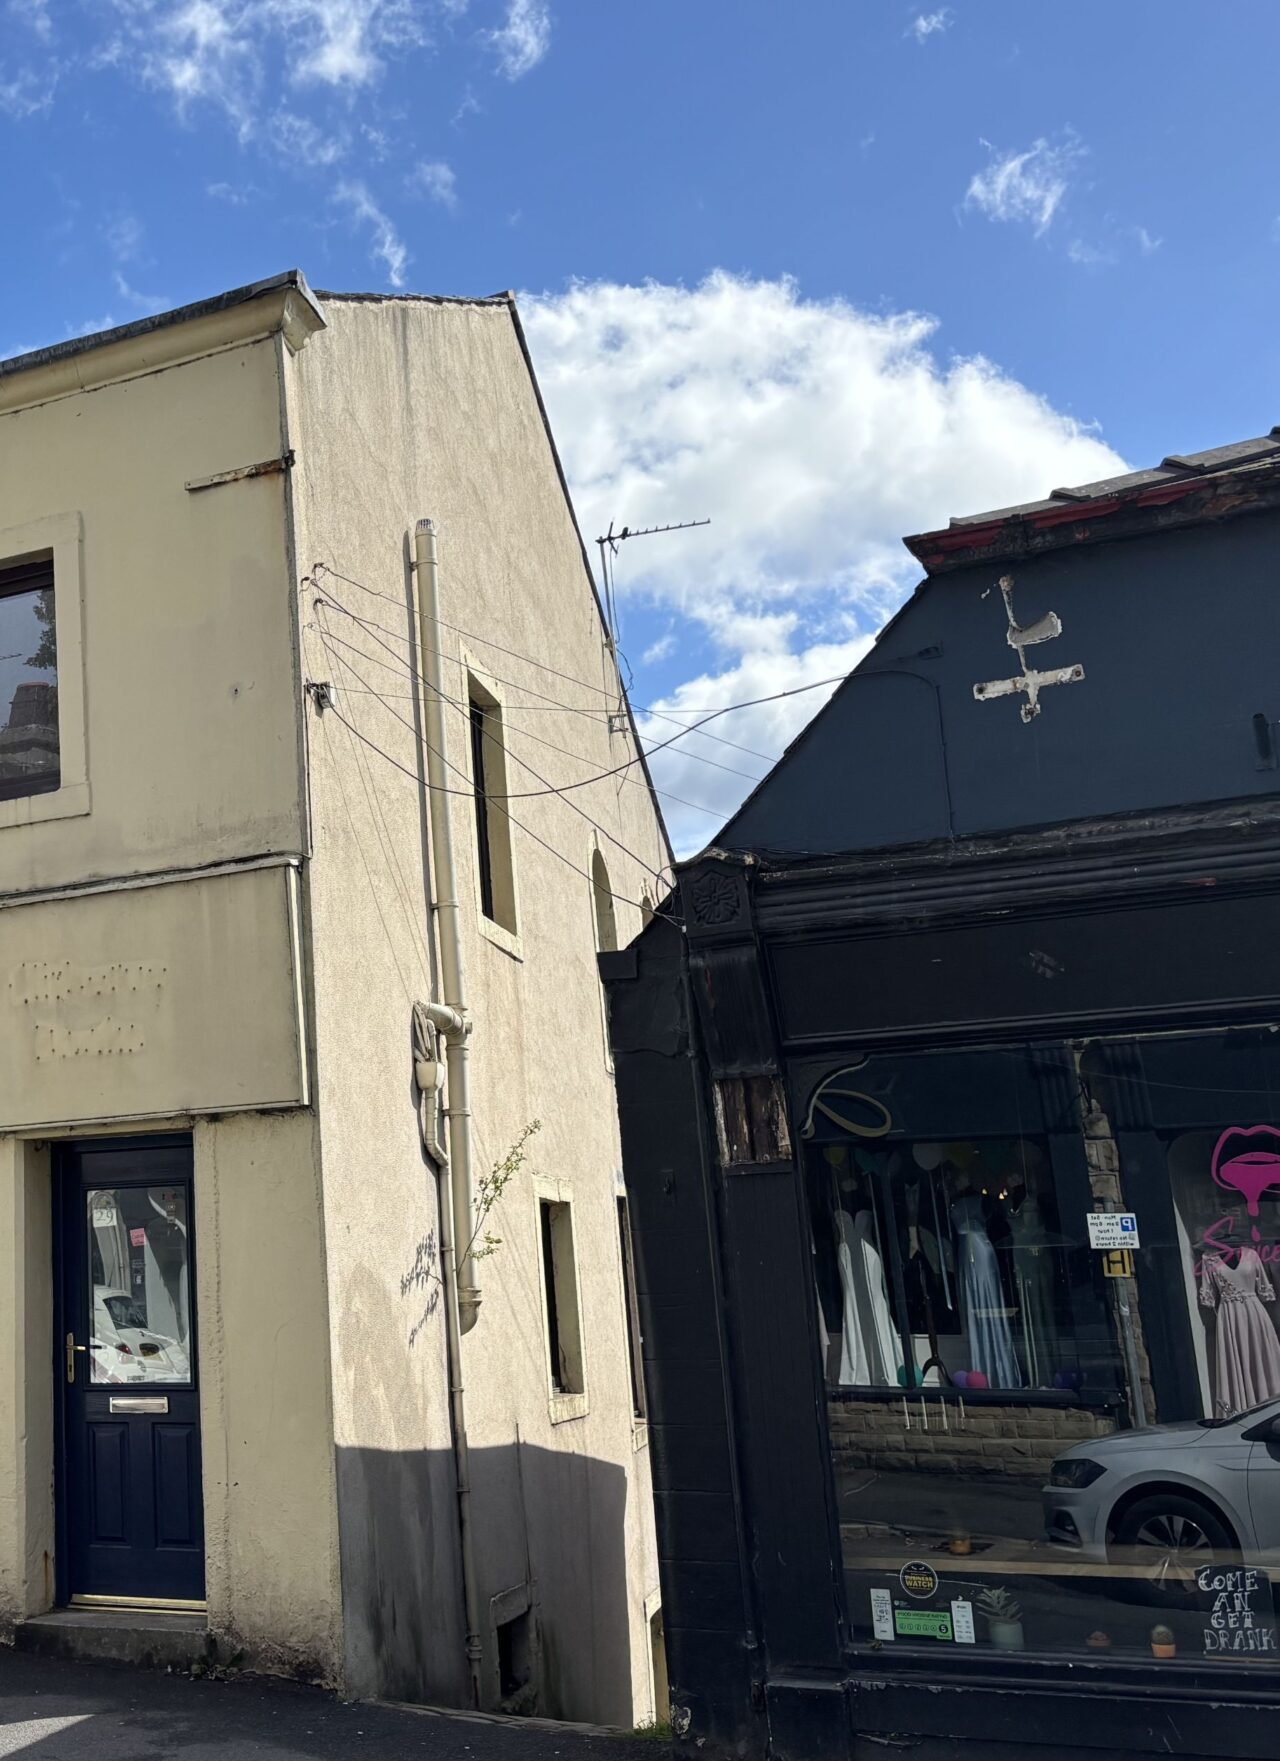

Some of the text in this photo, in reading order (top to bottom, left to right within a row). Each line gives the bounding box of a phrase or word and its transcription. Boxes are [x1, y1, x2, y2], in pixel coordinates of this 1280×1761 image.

[95, 1211, 113, 1225] 29
[906, 1580, 933, 1588] WATCH
[1198, 1568, 1259, 1592] COME
[1212, 1592, 1251, 1612] AN
[1211, 1611, 1255, 1628] GET
[940, 1625, 947, 1633] 5
[1204, 1628, 1277, 1651] DRANK
